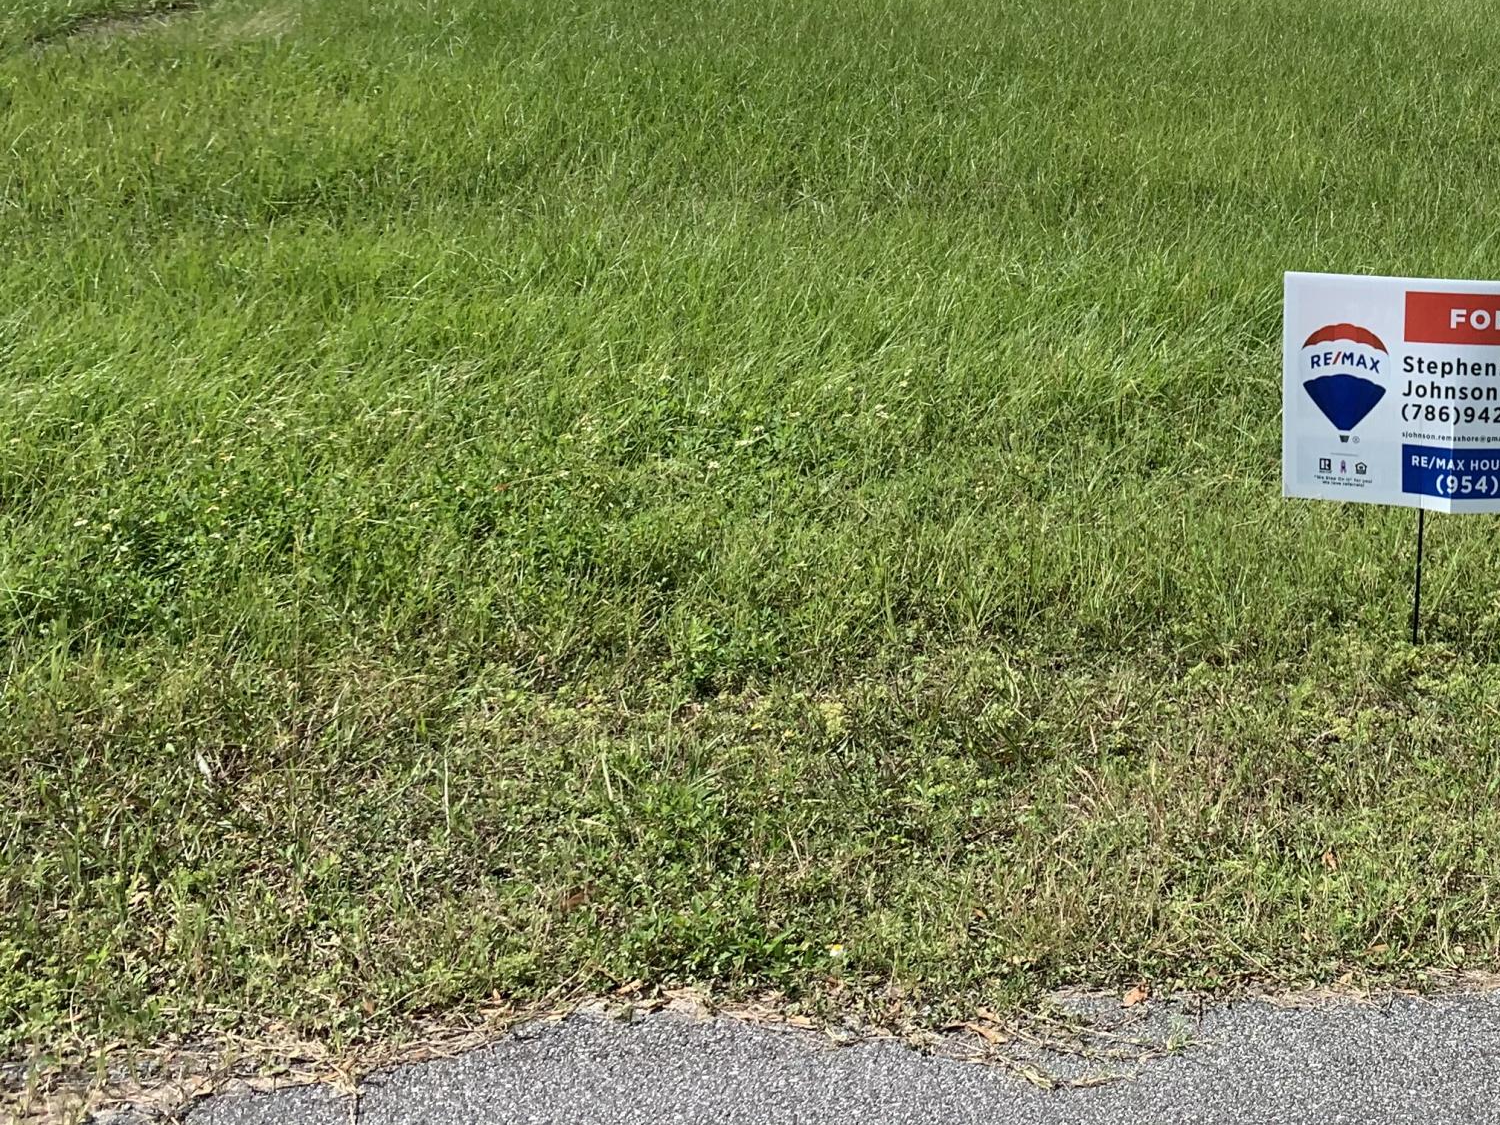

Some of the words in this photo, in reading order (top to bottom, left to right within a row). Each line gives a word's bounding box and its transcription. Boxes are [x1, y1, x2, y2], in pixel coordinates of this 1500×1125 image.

[1310, 351, 1380, 374] RE/MAX
[1402, 380, 1498, 401] Johnson
[1411, 455, 1465, 471] RE/MAX
